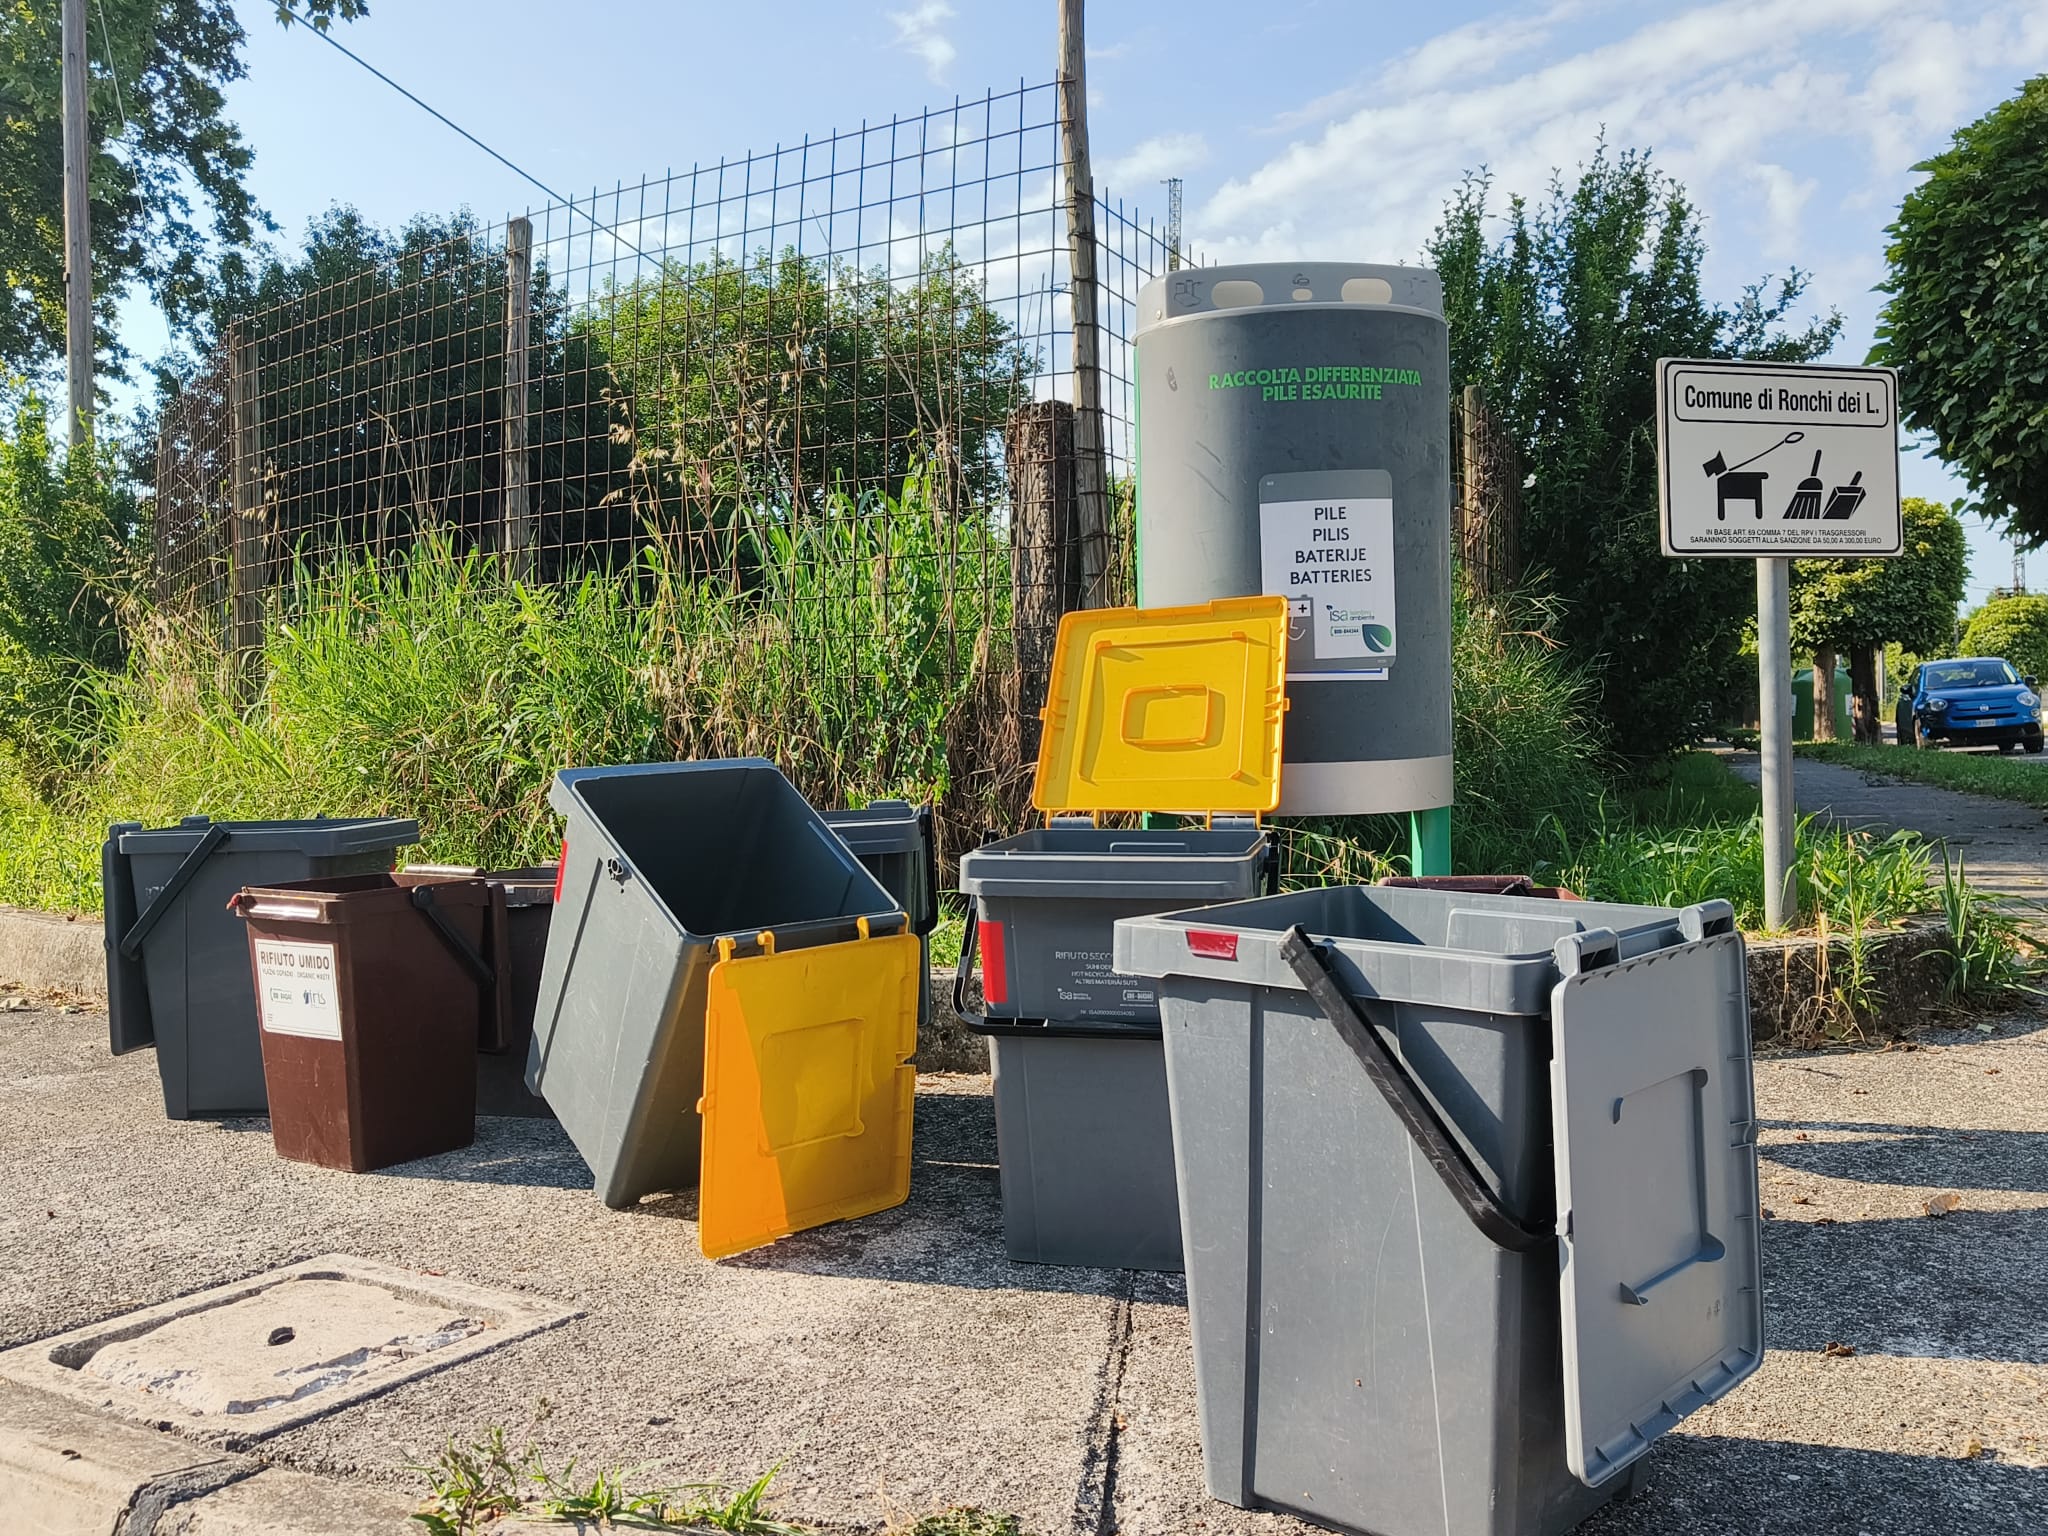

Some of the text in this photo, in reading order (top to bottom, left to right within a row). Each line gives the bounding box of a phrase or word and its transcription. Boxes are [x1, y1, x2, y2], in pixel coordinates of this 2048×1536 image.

[1208, 366, 1422, 390] RACCOLTA DIFFERENZIATA
[1262, 384, 1382, 401] PILE ESAURITE
[1684, 384, 1880, 414] Comune di Ronchi dei L.
[1314, 506, 1347, 521] PILE
[1313, 527, 1350, 542] PILIS
[1705, 528, 1713, 536] IN
[1714, 528, 1733, 536] BASE
[1818, 529, 1867, 537] TRASGRESSORI
[1728, 536, 1761, 544] SOGGETTI
[1761, 536, 1779, 544] ALLA
[1779, 536, 1812, 544] SANZIONE
[1295, 548, 1367, 564] BATERIJE
[1290, 568, 1372, 585] BATTERIES
[260, 951, 330, 970] RIFIUTO UMIDO
[1055, 951, 1088, 960] RIFIUTO
[1058, 988, 1073, 1000] isa
